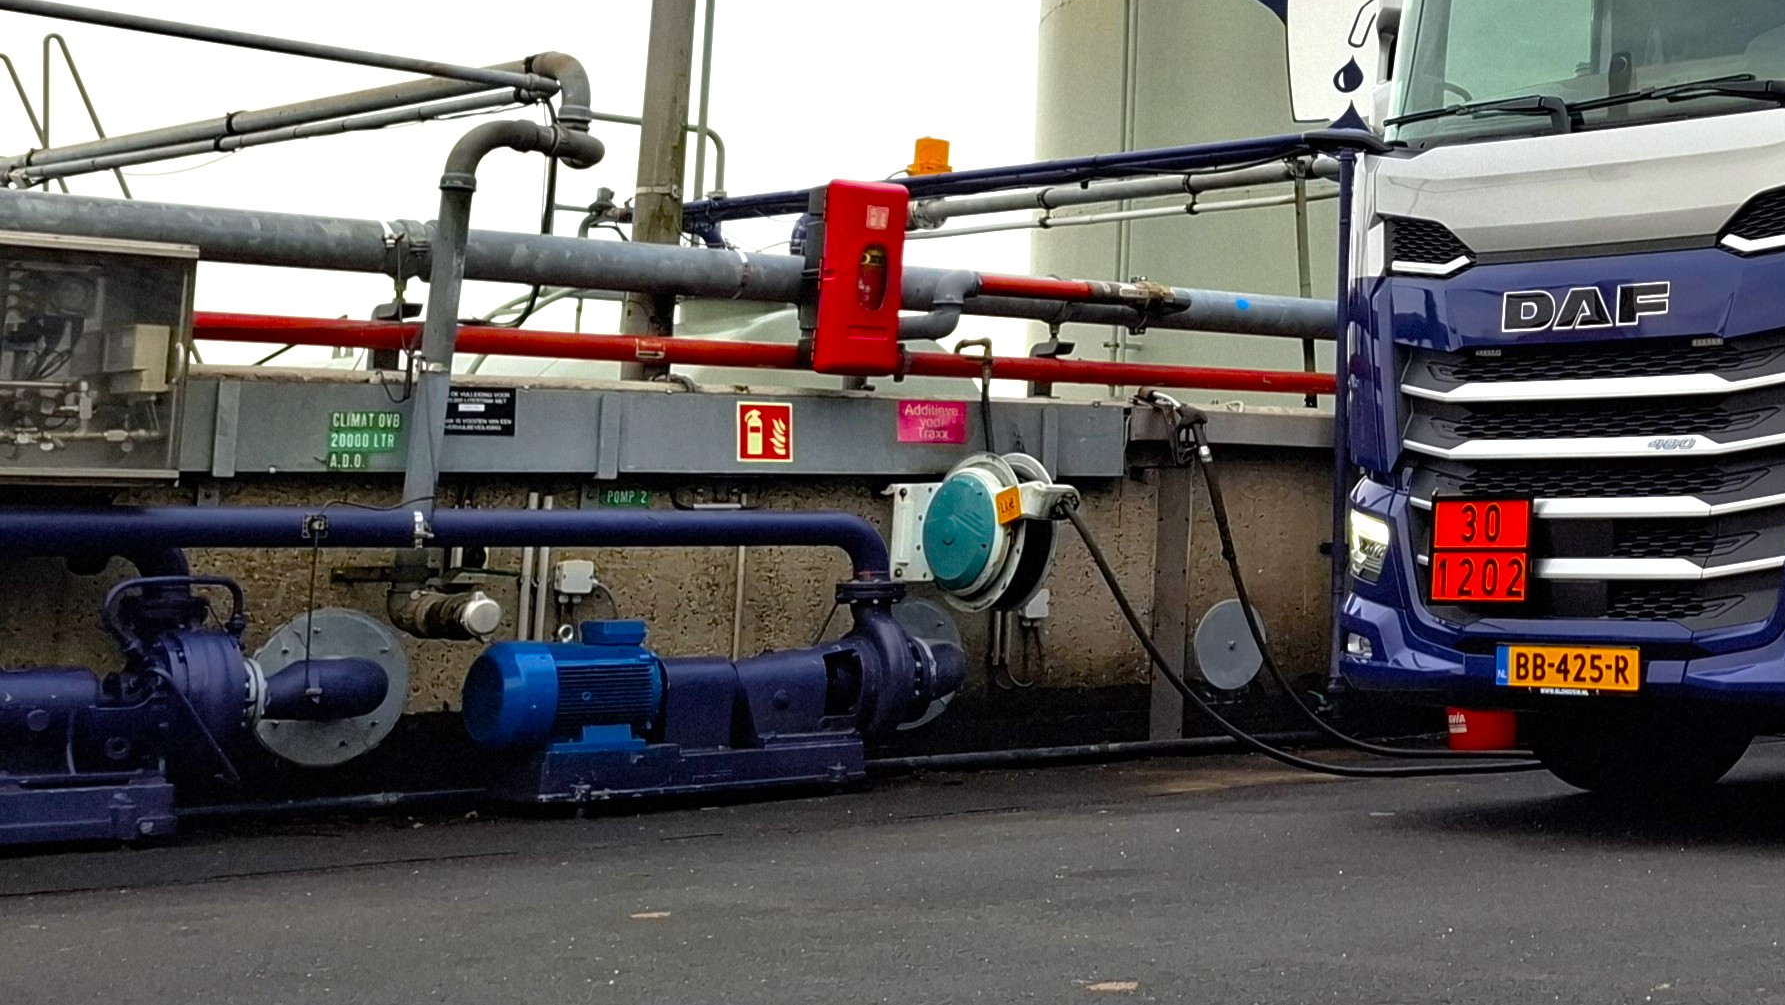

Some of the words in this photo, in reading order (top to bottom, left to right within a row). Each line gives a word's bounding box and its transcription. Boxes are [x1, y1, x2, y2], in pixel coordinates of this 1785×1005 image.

[1501, 281, 1671, 333] DAF
[333, 413, 374, 428] CLIMAT
[378, 413, 400, 428] OVB
[330, 433, 369, 448] 20000
[373, 434, 395, 448] LTR
[607, 490, 635, 503] POMP
[640, 490, 648, 504] 2
[1461, 503, 1501, 542] 30
[1438, 558, 1524, 596] 1202
[1497, 669, 1508, 679] NL
[1515, 652, 1629, 684] BB-425-R
